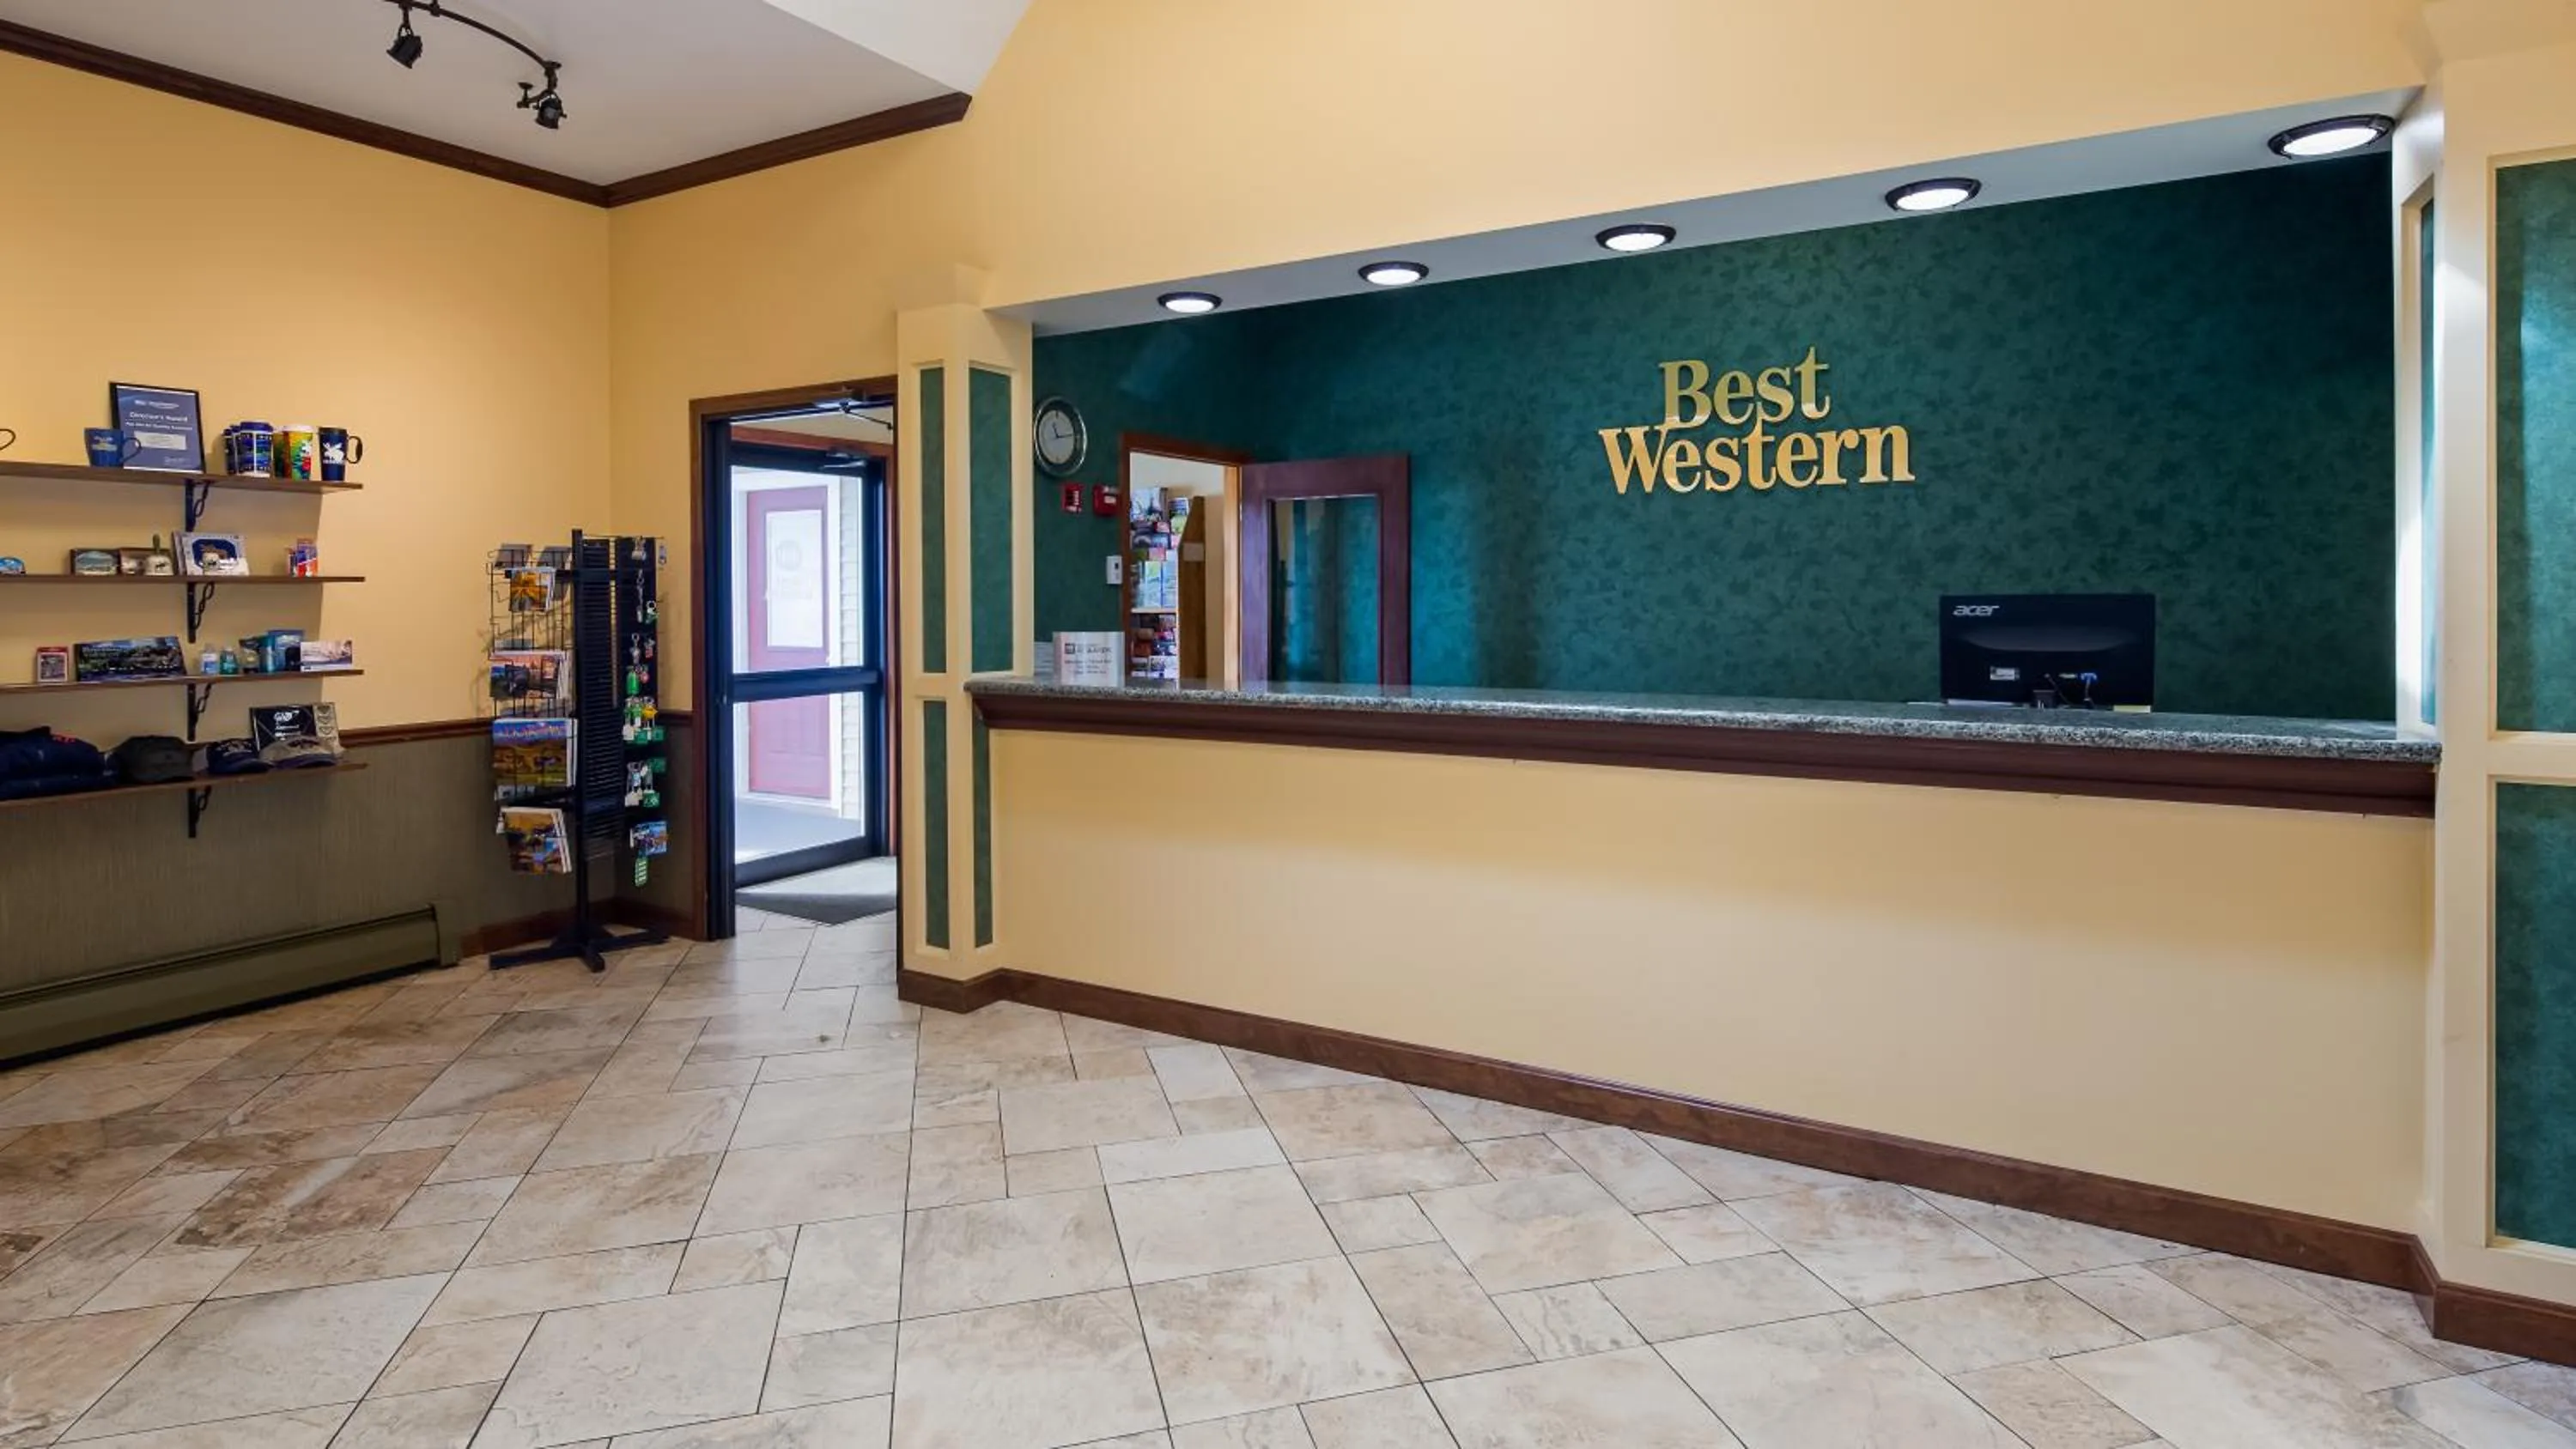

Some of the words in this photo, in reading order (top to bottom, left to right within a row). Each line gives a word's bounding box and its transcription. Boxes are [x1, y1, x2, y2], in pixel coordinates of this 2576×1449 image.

[1659, 346, 1831, 429] Best
[1598, 402, 1916, 494] Western
[1953, 605, 2000, 616] acer
